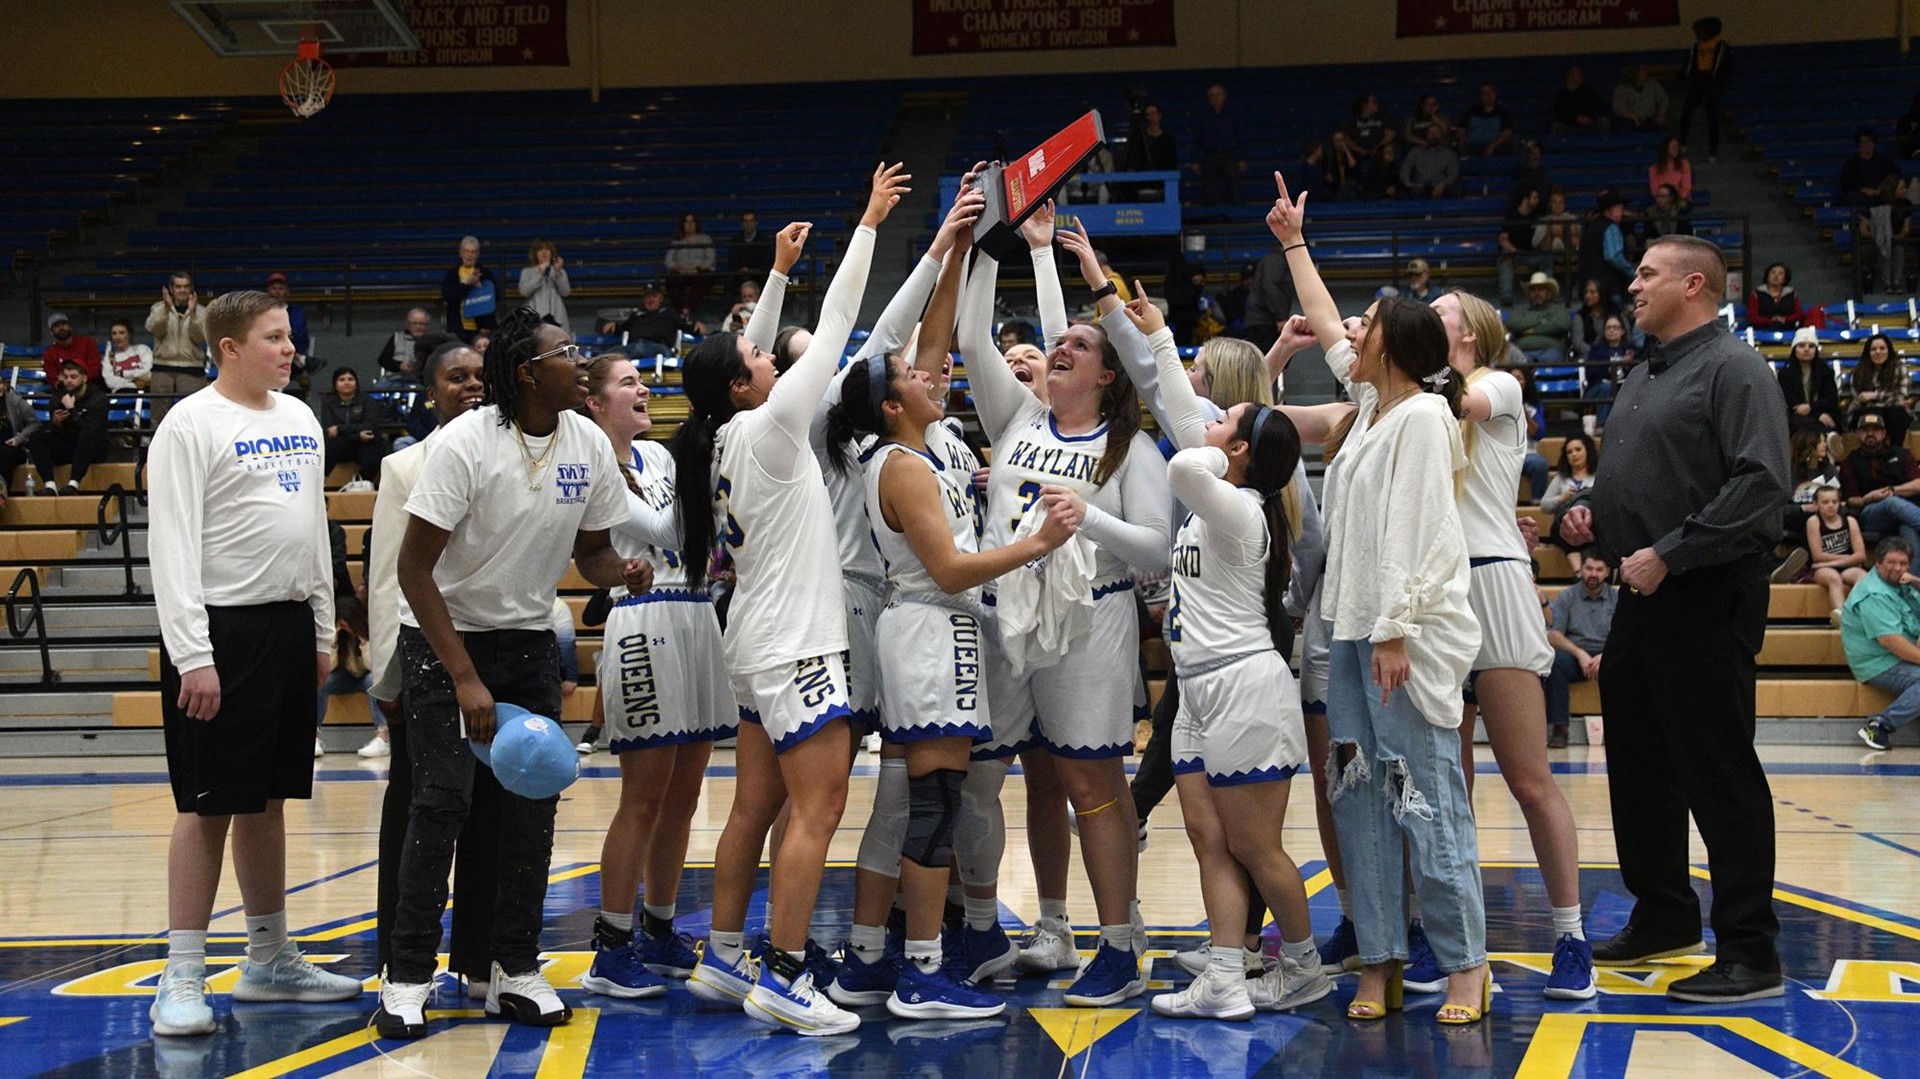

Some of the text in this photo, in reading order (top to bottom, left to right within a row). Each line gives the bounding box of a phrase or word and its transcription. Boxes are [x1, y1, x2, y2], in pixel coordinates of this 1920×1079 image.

[463, 7, 498, 25] AND
[504, 5, 550, 24] FIELD
[963, 8, 1123, 32] CHAMPIONS 1988
[1527, 9, 1601, 27] PROGRAM
[475, 27, 519, 46] 1988
[1050, 29, 1109, 46] DIVISION
[436, 48, 494, 64] DIVISION
[617, 633, 661, 728] QUEENS
